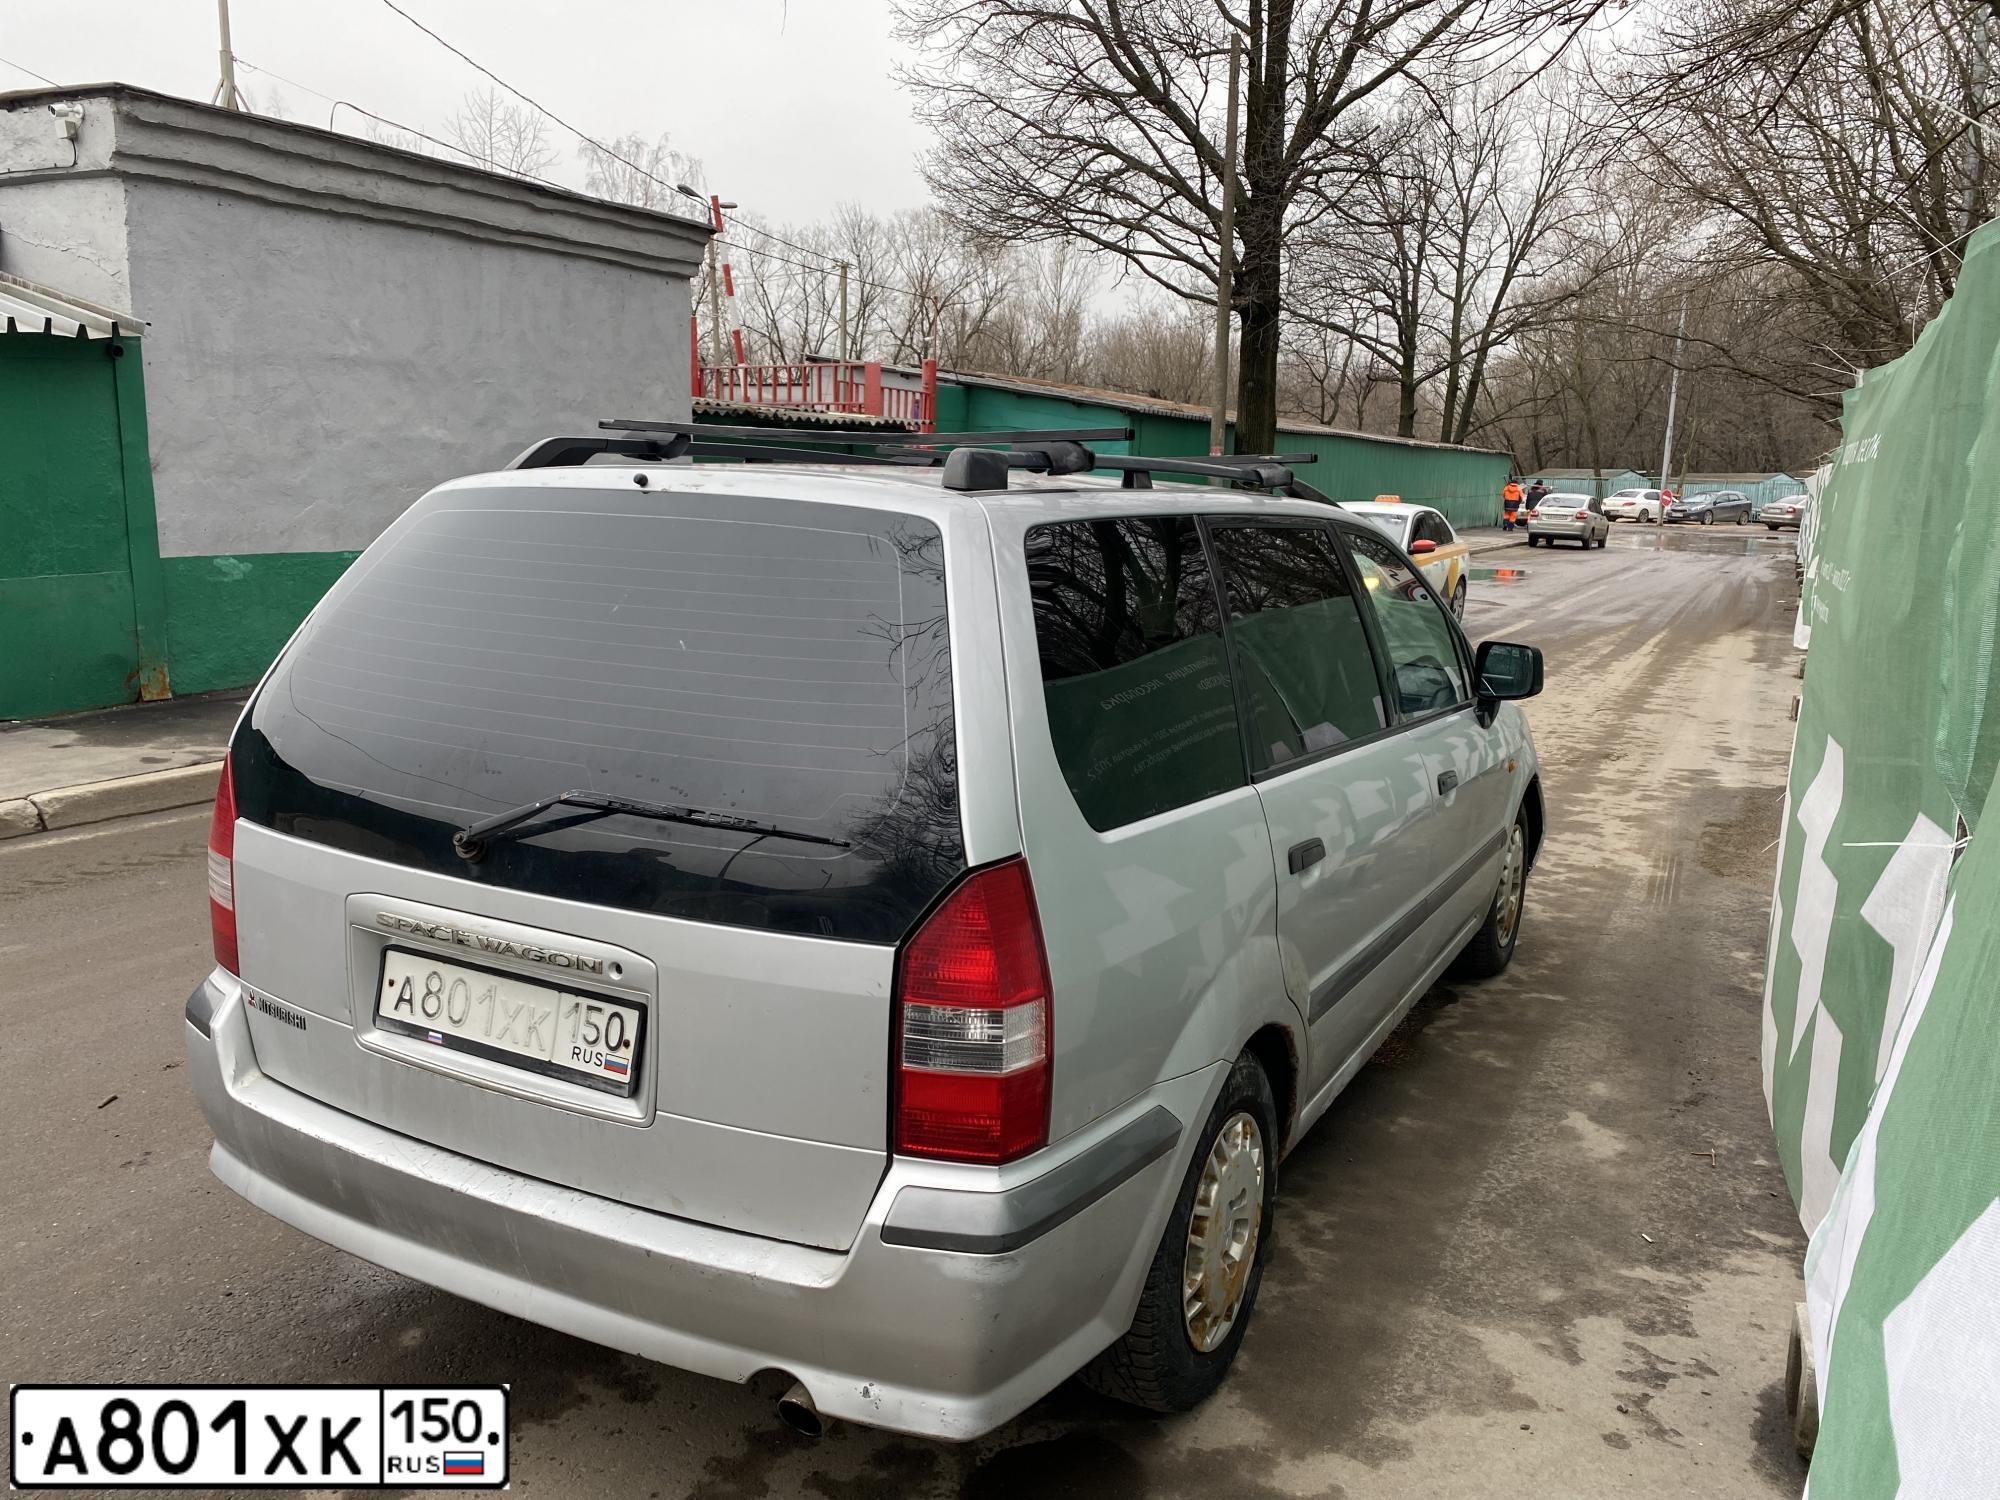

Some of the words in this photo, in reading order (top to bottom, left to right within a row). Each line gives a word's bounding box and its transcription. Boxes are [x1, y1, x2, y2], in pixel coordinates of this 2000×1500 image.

[376, 911, 472, 947] SPACE
[476, 935, 603, 975] WAGON
[257, 996, 306, 1031] MITSUBISHI
[564, 1001, 626, 1052] 150
[571, 1046, 604, 1068] RUS
